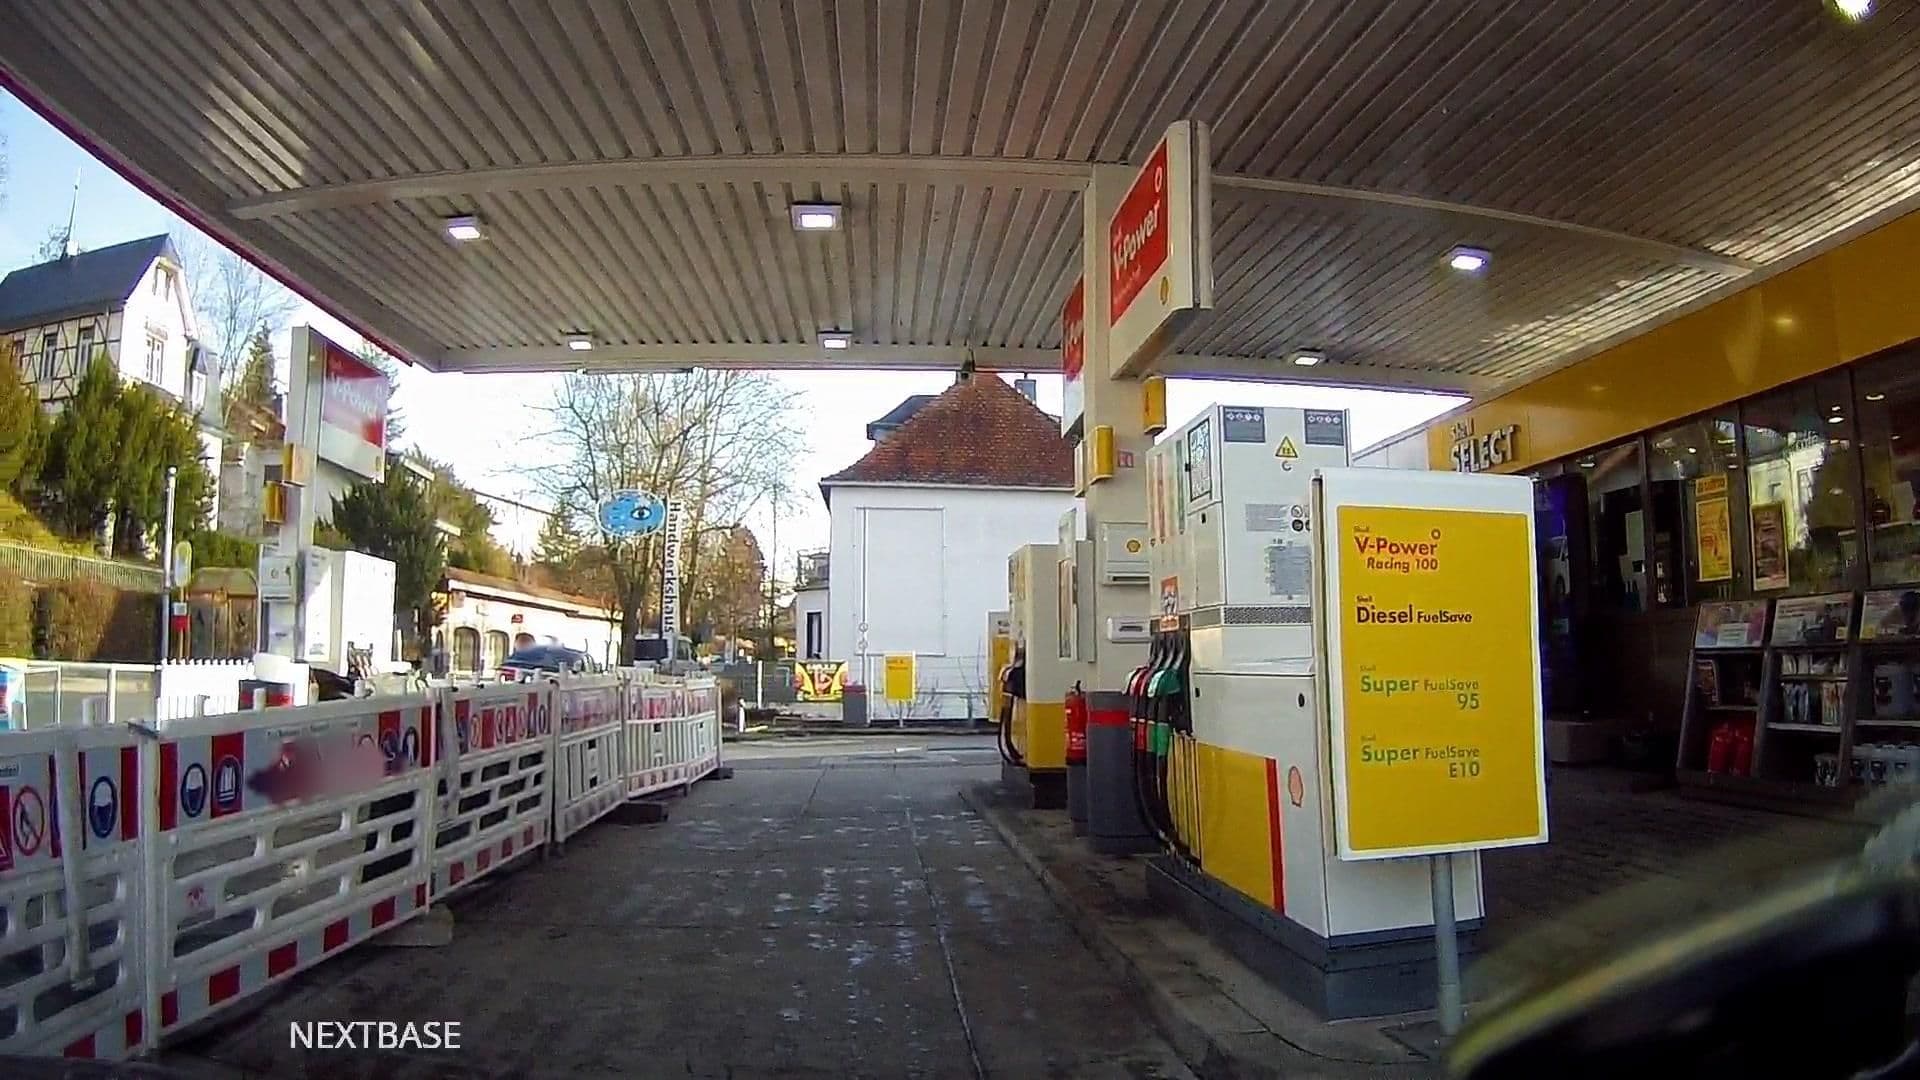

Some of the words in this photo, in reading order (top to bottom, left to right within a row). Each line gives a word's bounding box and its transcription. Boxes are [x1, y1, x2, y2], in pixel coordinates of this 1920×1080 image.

[1451, 424, 1520, 472] SELECT
[1354, 536, 1437, 556] V-Power
[663, 501, 682, 633] Handwerkshaus
[1367, 557, 1410, 574] Racing
[1416, 558, 1438, 570] 100
[1356, 604, 1413, 624] Diesel
[1417, 610, 1472, 623] FuelSave
[1360, 675, 1418, 697] Super
[1423, 679, 1479, 691] FuelSave
[1457, 693, 1480, 710] 95
[1361, 745, 1419, 766] Super
[1424, 745, 1480, 760] FuelSave
[1449, 761, 1480, 777] E10
